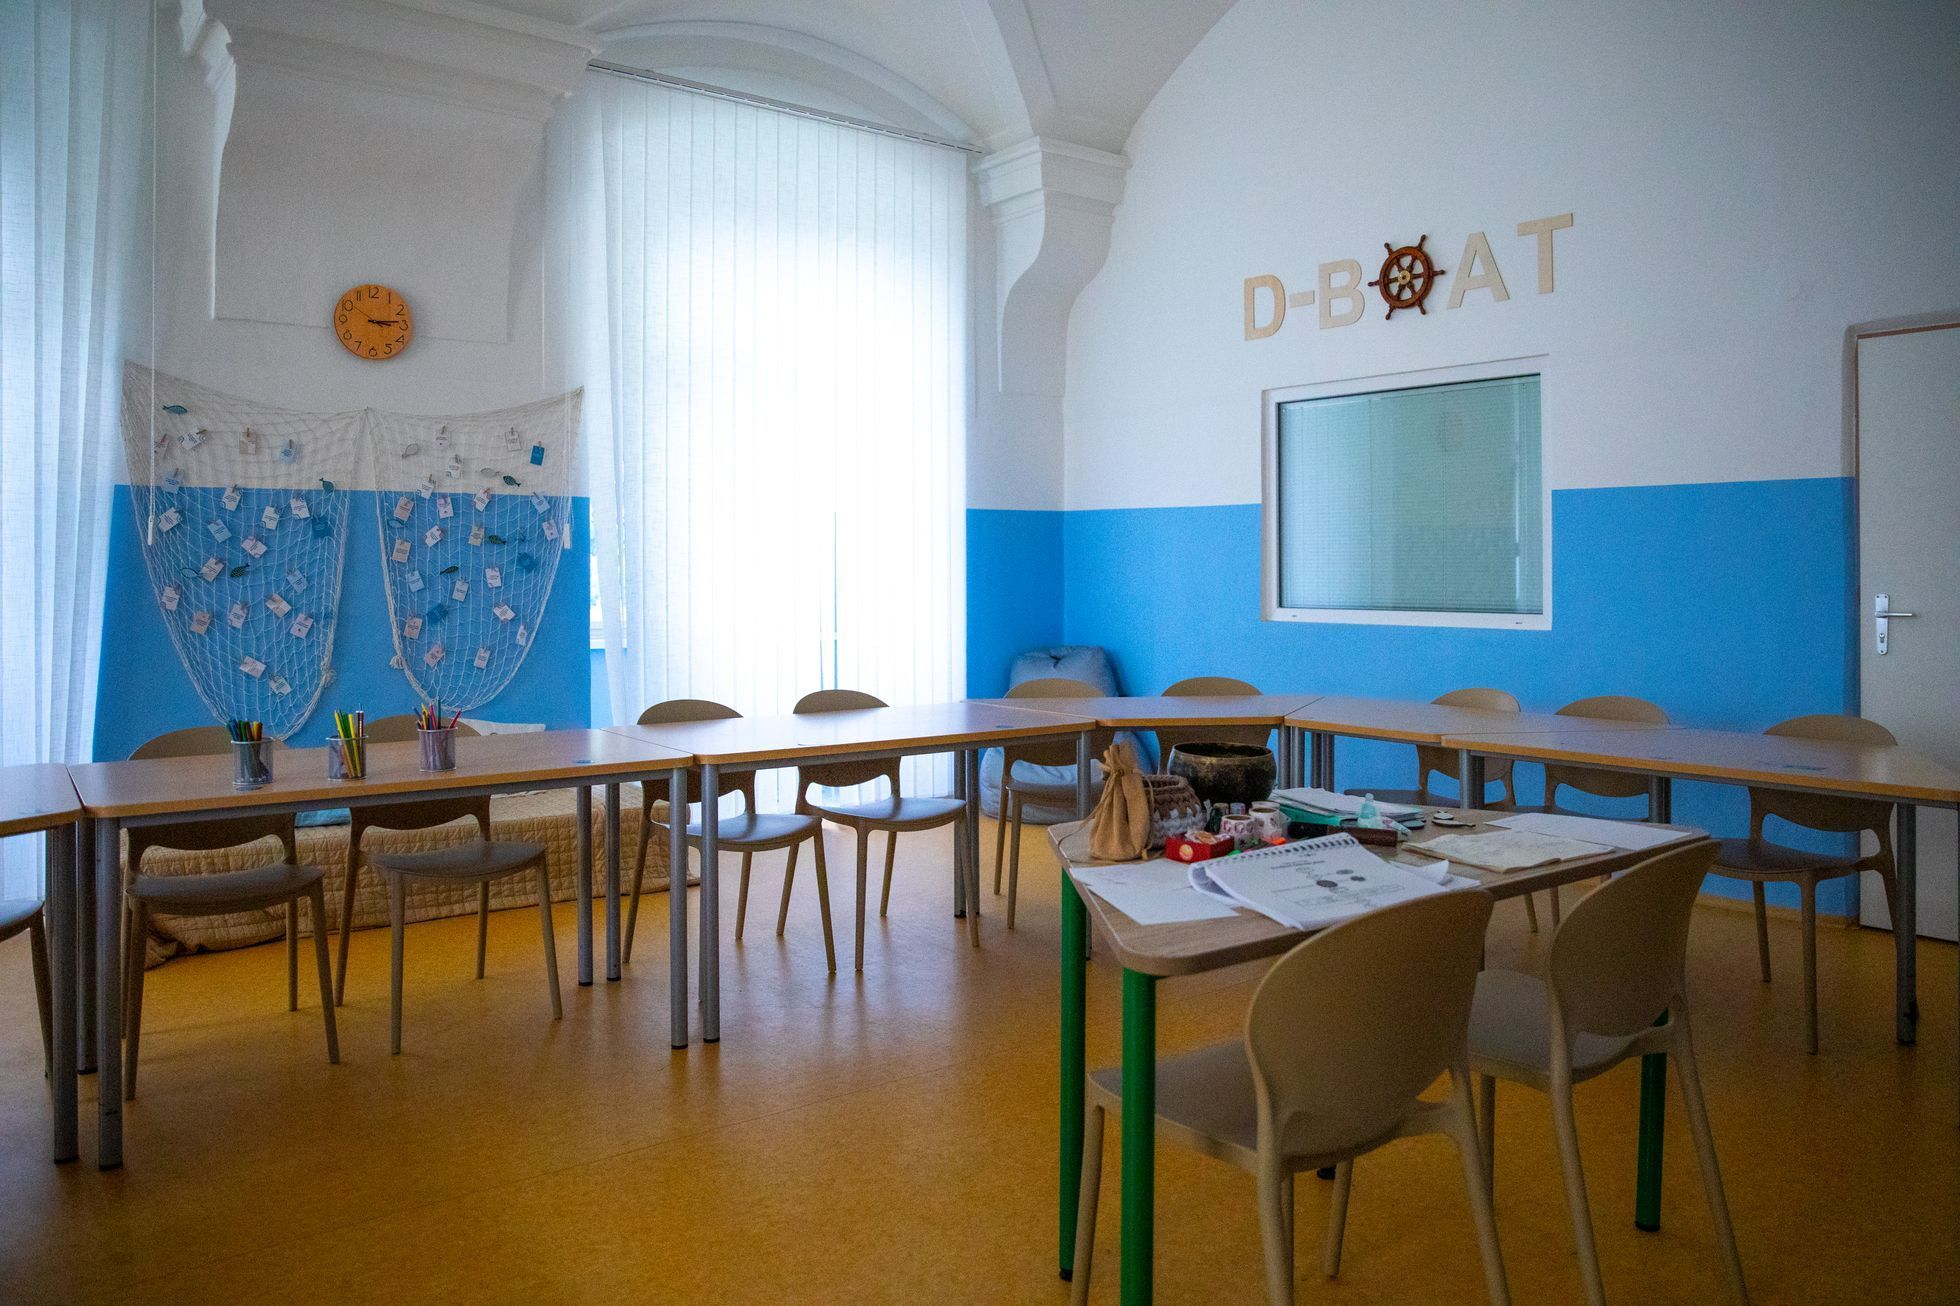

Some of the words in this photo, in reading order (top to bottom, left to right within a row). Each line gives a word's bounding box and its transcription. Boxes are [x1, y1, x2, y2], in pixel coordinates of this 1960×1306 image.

[357, 290, 361, 301] 11
[368, 287, 379, 298] 12
[342, 300, 353, 311] 10
[396, 304, 405, 316] 2
[339, 314, 348, 325] 9
[399, 320, 408, 331] 3
[395, 335, 404, 345] 4
[355, 341, 362, 351] 7
[369, 346, 377, 357] 6
[384, 344, 392, 355] 5
